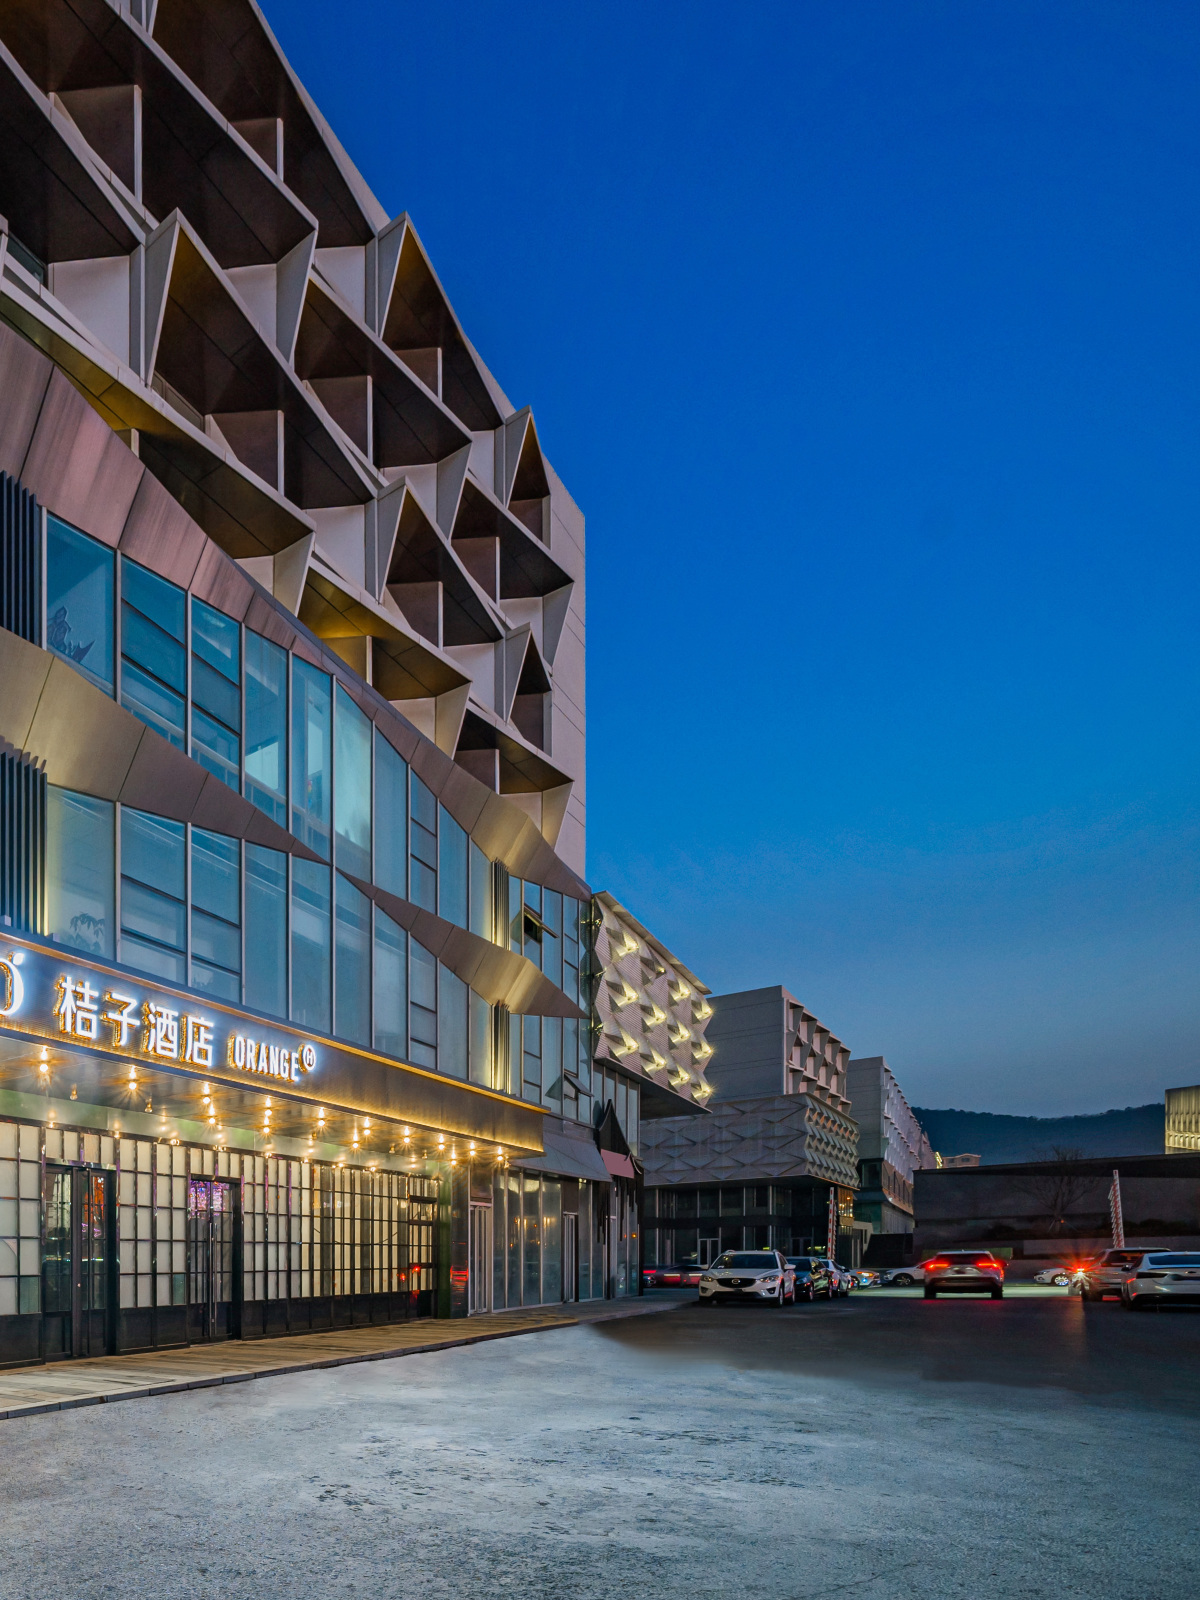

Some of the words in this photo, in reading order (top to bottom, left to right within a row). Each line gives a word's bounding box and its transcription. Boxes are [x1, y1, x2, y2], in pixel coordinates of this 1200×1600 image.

[60, 976, 214, 1067] 桔子酒店
[235, 1034, 300, 1081] ORANGE
